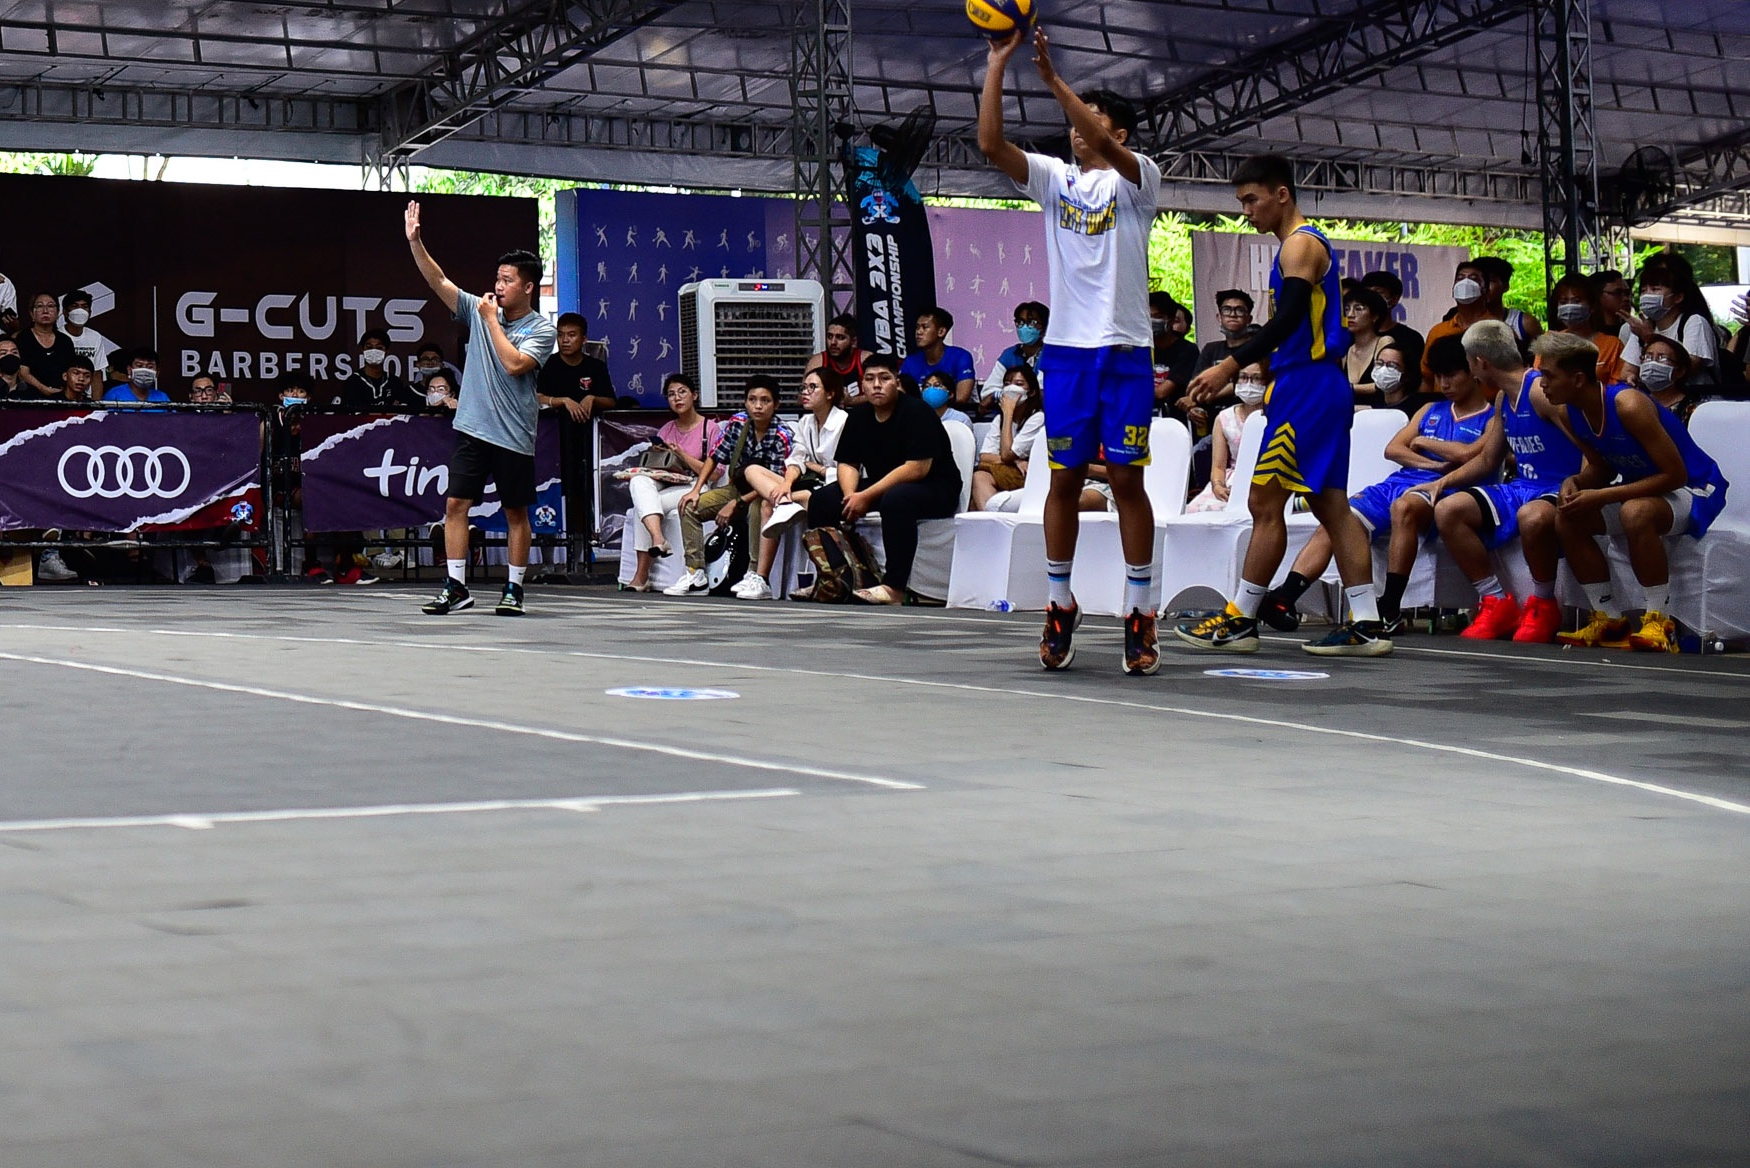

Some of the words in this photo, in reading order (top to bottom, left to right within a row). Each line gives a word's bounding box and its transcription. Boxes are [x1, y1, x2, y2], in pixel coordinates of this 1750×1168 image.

[865, 232, 887, 292] 3X3
[175, 290, 429, 346] G-CUTS
[886, 234, 908, 360] CHAMPIONSHIP
[872, 300, 893, 355] VBA
[180, 348, 423, 383] BARBERSOP
[1123, 424, 1149, 447] 32
